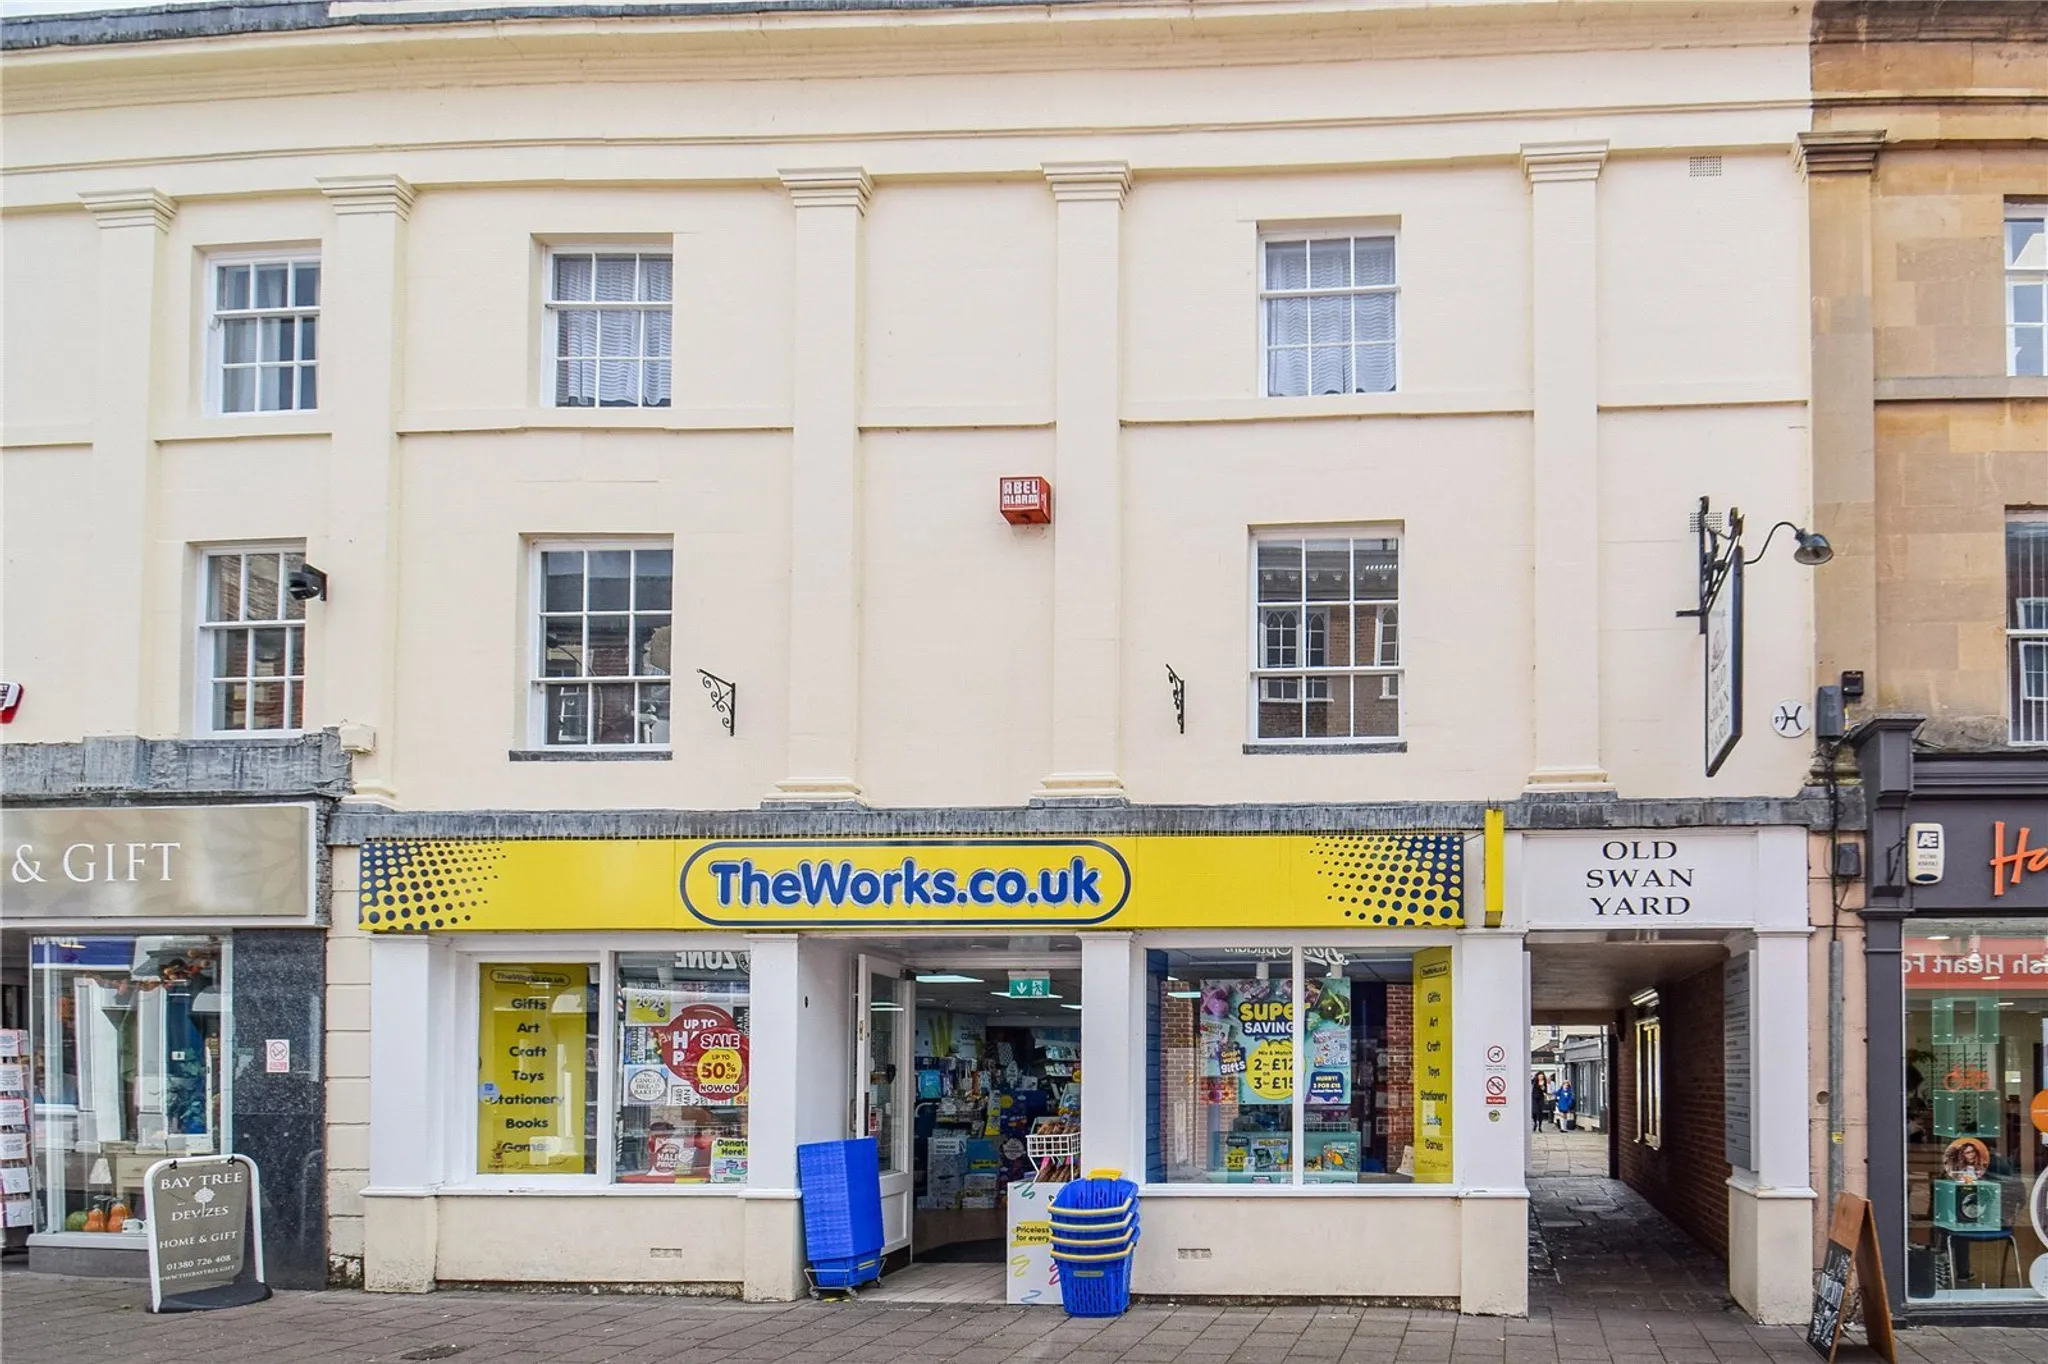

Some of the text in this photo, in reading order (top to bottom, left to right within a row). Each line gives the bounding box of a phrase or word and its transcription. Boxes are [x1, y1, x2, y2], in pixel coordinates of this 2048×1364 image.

[1004, 480, 1038, 494] ABEL
[1003, 494, 1038, 504] ALARM
[1602, 841, 1677, 860] OLD
[11, 842, 181, 883] & GIFT
[708, 856, 1101, 907] TheWorks.co.uk
[1586, 868, 1695, 888] SWAN
[1589, 896, 1691, 915] YARD
[511, 998, 547, 1010] Gifts
[1240, 1002, 1311, 1021] SUPE
[516, 1022, 541, 1033] Art
[683, 1019, 699, 1029] UP
[700, 1034, 740, 1049] SALE
[508, 1046, 548, 1057] Craft
[1220, 1061, 1246, 1074] gifts
[1254, 1058, 1262, 1070] 2
[512, 1070, 545, 1083] Toys
[1254, 1077, 1262, 1089] 3
[700, 1084, 739, 1092] NOW ON
[505, 1117, 549, 1129] Books
[502, 1142, 549, 1153] Game
[721, 1147, 746, 1156] Here!
[160, 1171, 244, 1190] BAY TREE
[171, 1206, 229, 1221] DEVIZES
[160, 1231, 238, 1249] HOME & GIFT
[166, 1260, 194, 1271] 01380
[197, 1257, 213, 1266] 726
